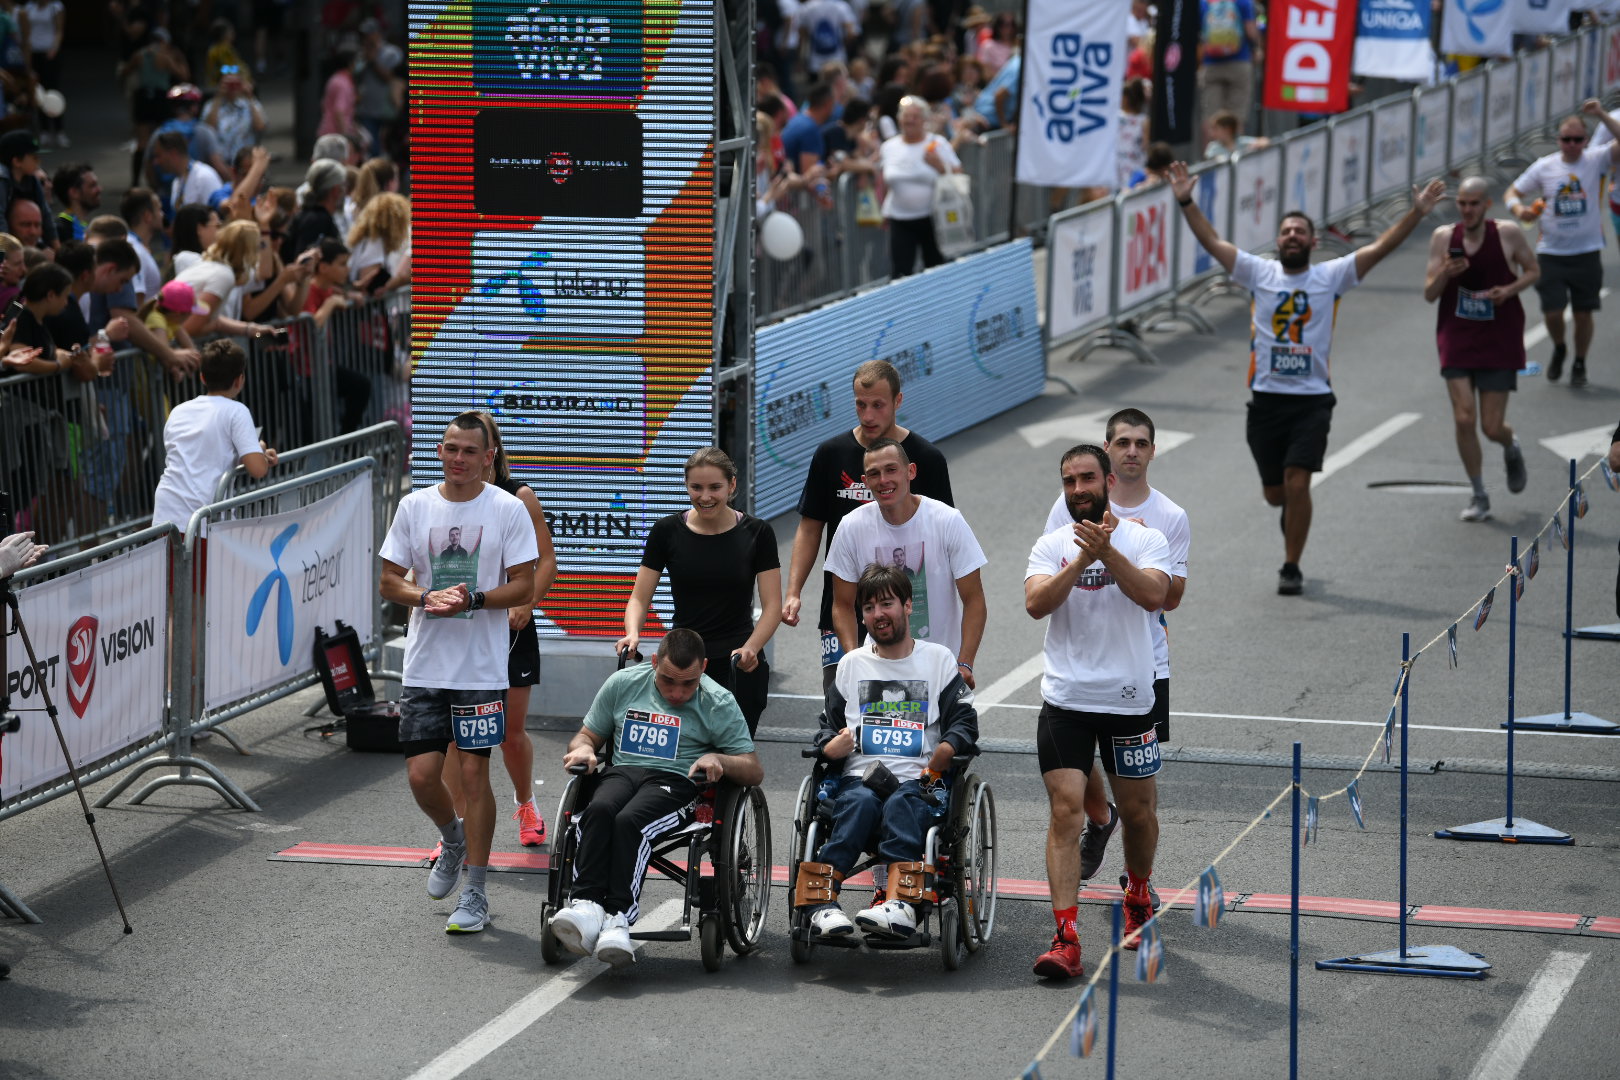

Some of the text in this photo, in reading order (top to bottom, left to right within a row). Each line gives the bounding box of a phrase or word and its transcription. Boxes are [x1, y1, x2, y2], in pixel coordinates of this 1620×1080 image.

[1361, 11, 1423, 30] UNIQA
[1275, 355, 1306, 370] 2004
[836, 489, 876, 501] JAGO
[544, 512, 631, 537] RMIN
[7, 617, 155, 705] PORT VISION
[866, 701, 921, 713] JOKER
[459, 717, 498, 738] 6795
[629, 724, 669, 747] 6796
[872, 728, 913, 747] 6793
[1123, 742, 1159, 767] 6890
